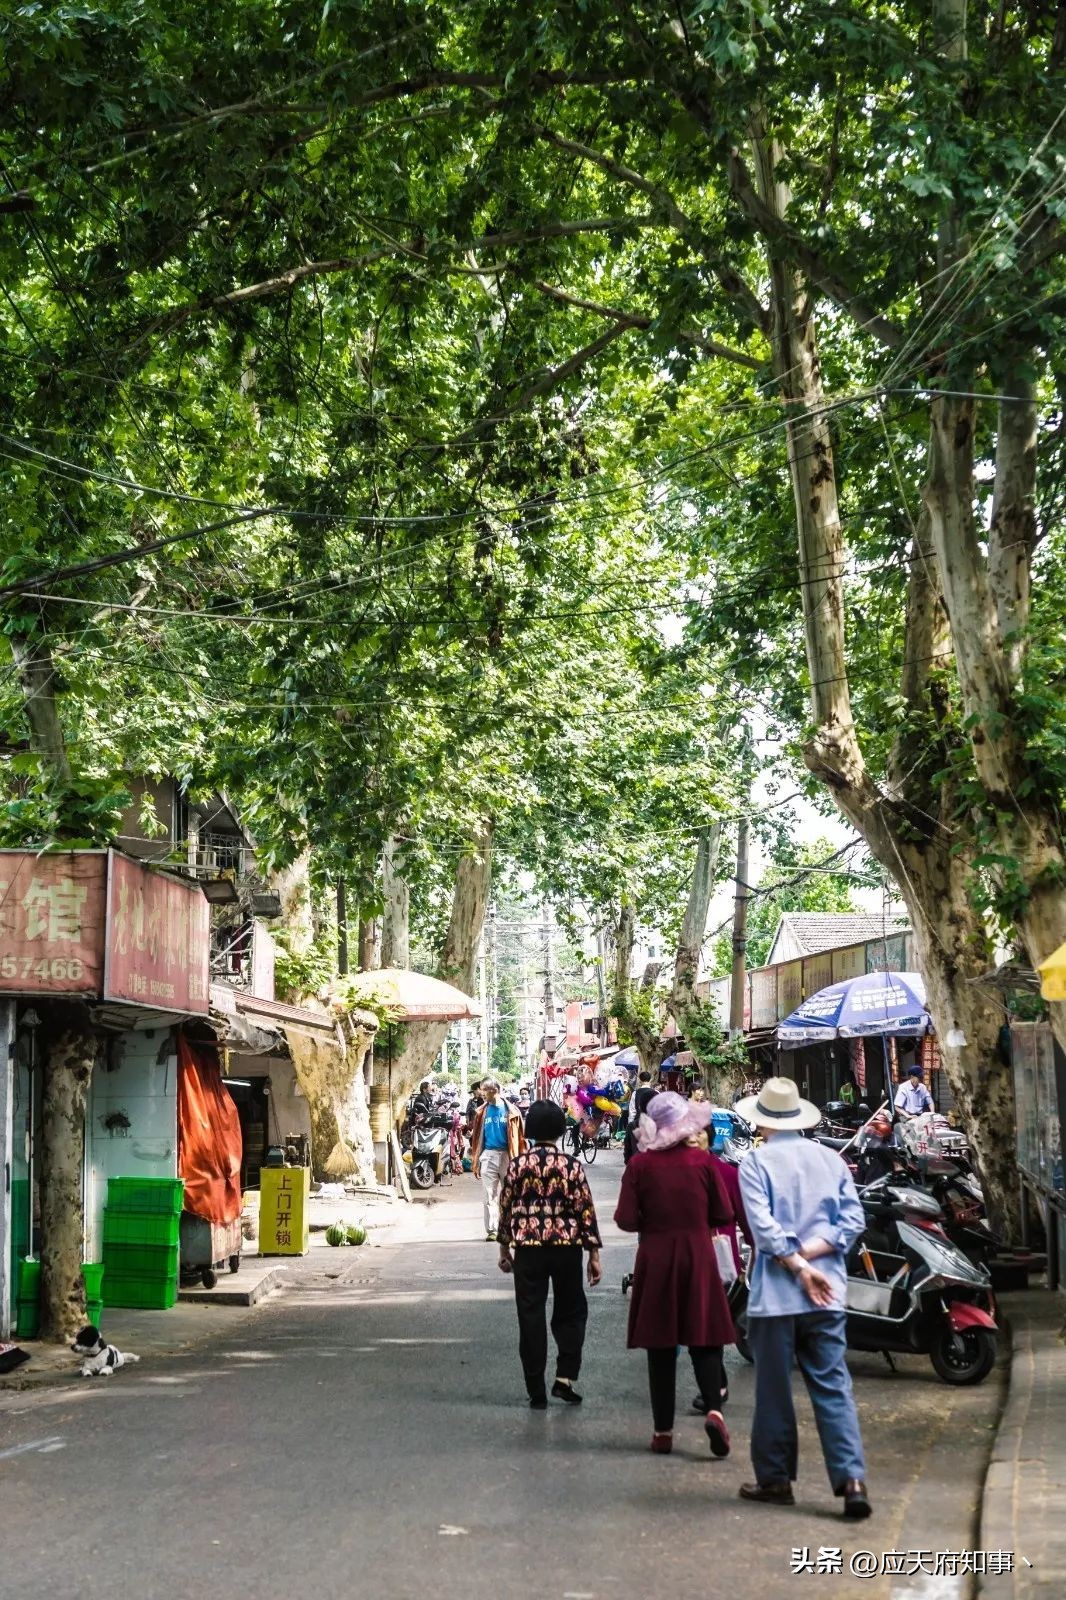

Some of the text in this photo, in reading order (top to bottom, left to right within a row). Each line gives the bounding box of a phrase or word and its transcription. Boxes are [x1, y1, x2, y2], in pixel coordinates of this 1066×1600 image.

[0, 877, 88, 942] 馆
[1, 956, 84, 980] 57466
[276, 1175, 292, 1246] 上门开锁
